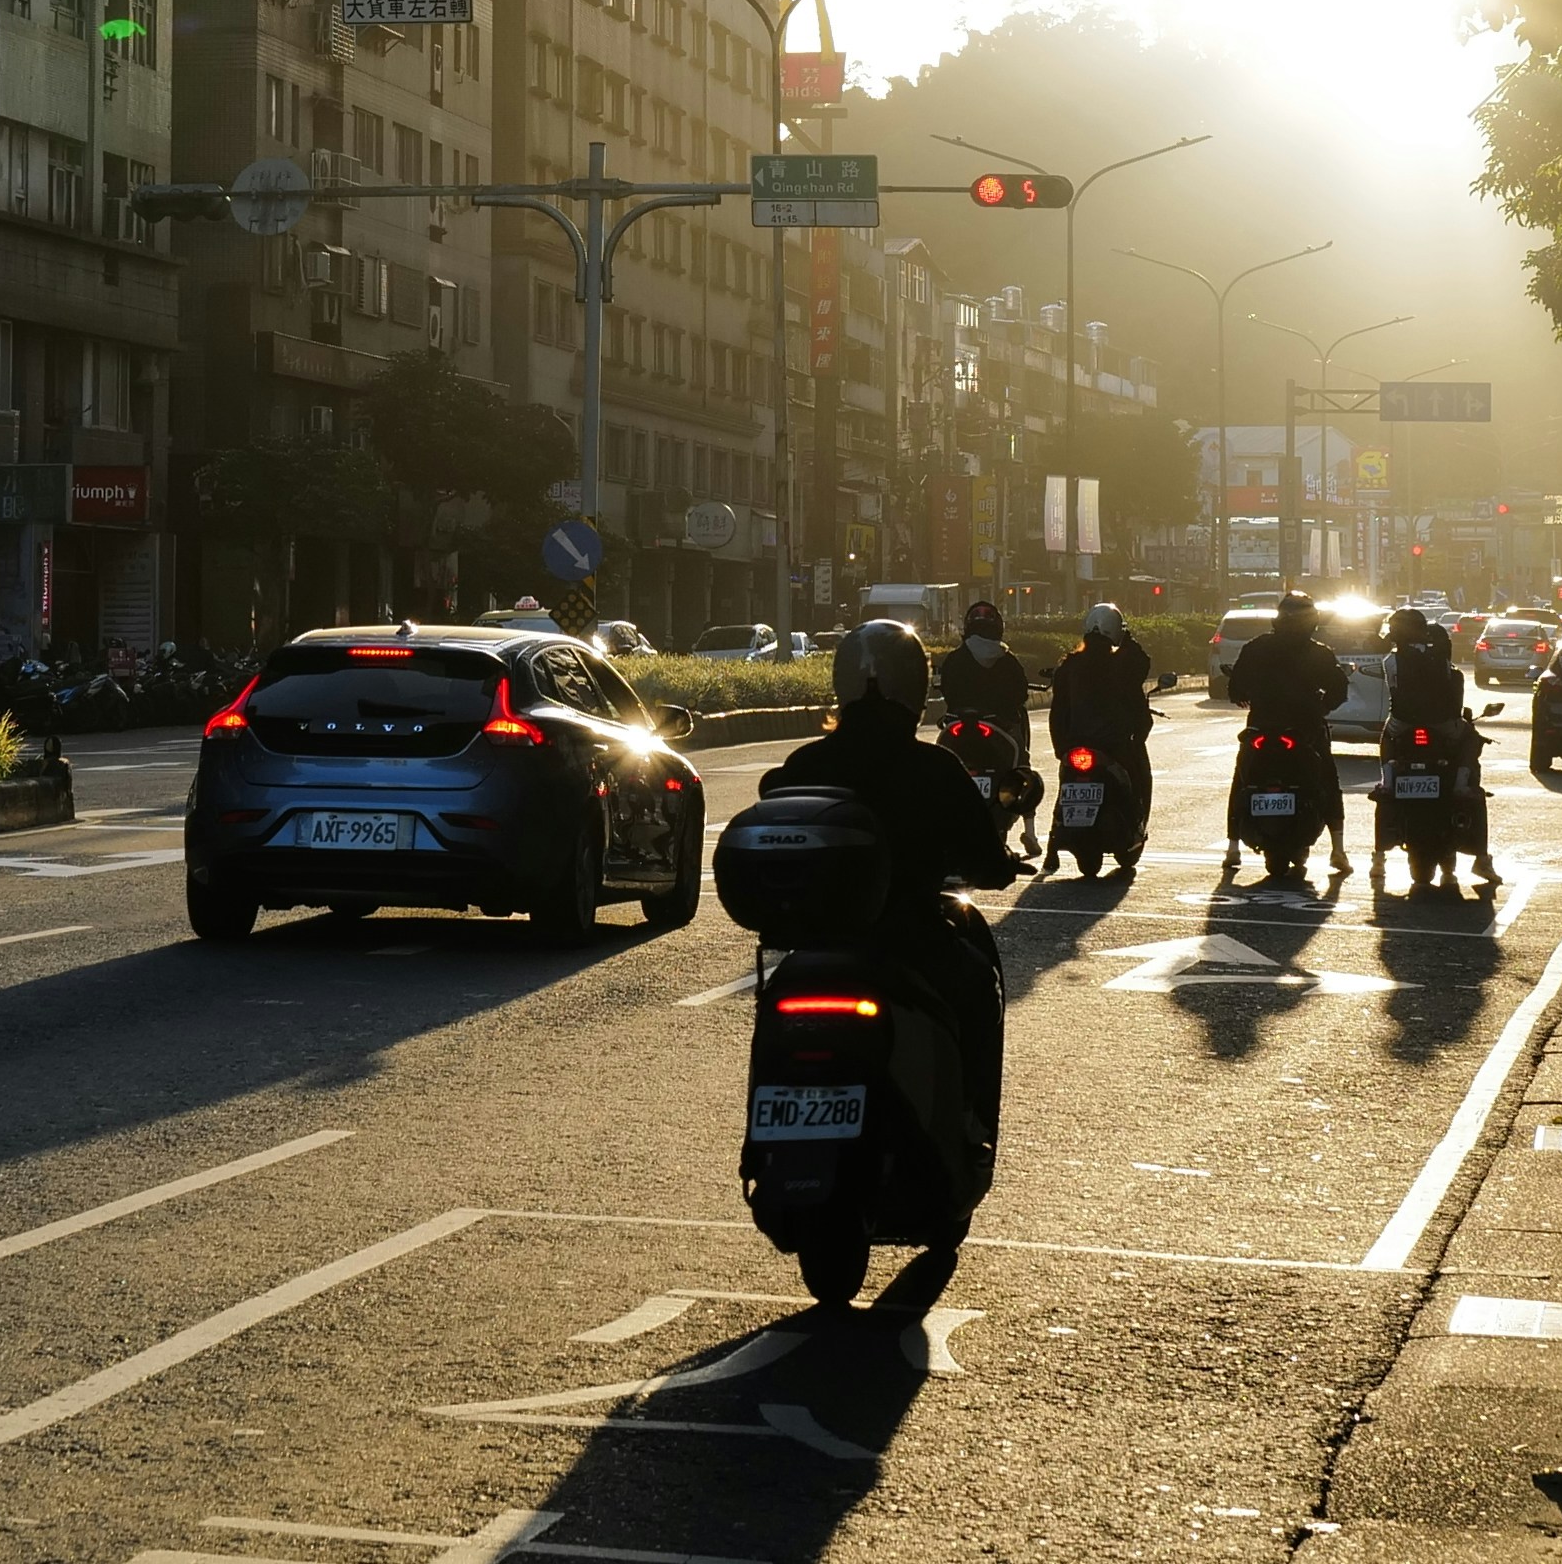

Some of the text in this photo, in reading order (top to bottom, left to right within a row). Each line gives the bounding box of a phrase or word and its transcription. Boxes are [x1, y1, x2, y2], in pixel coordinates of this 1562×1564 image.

[780, 66, 820, 85] 勞
[769, 160, 860, 179] 青山路
[772, 182, 833, 196] Qingshan
[298, 722, 424, 733] VOLVO
[758, 835, 806, 845] SHAD
